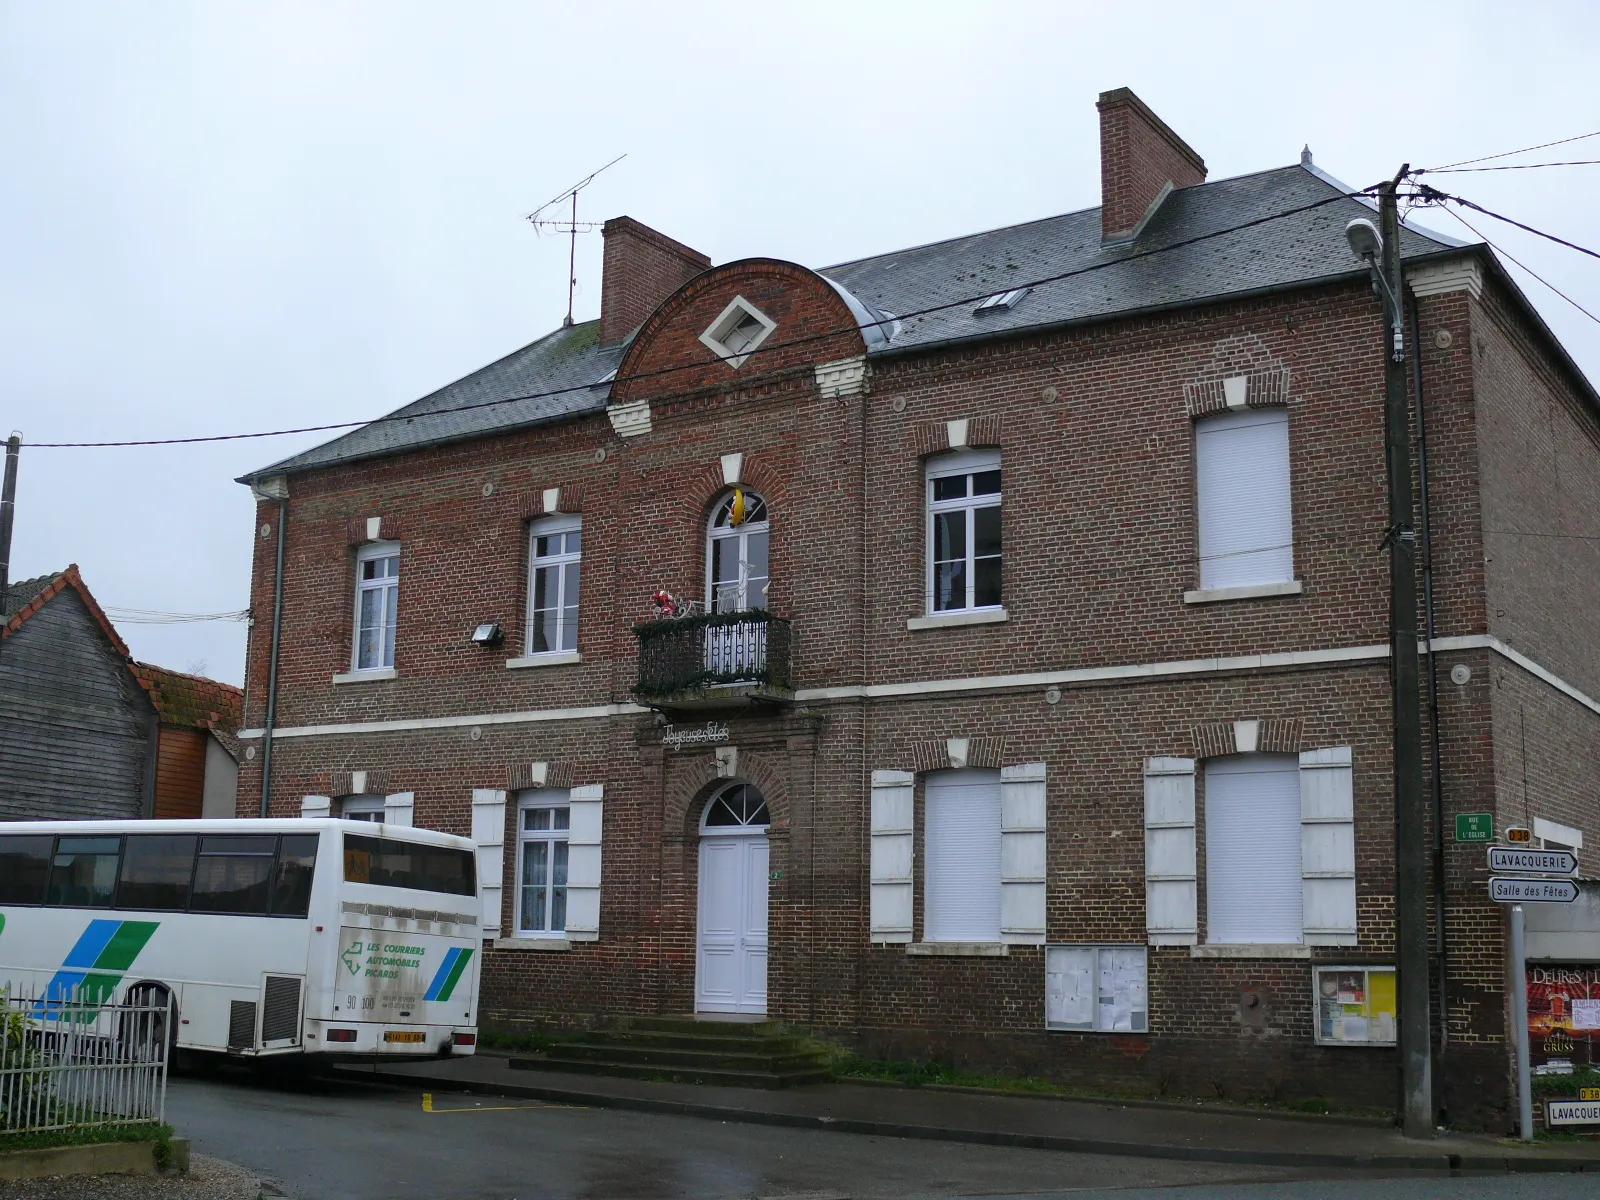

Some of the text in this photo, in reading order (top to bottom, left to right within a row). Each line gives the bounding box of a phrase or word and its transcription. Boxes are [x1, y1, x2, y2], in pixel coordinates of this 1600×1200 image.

[1509, 830, 1529, 841] D 38
[1495, 854, 1566, 868] LAVACQUERIE
[1497, 885, 1568, 897] Salle des Fêtes
[366, 943, 425, 956] LES COURRIERS
[366, 956, 420, 968] AUTOMOBILES
[365, 968, 399, 979] PICARDS
[347, 995, 357, 1009] 90
[362, 997, 375, 1010] 100
[1543, 1042, 1574, 1051] GRUSS
[1581, 1090, 1600, 1099] D 38
[1552, 1107, 1600, 1119] LAVACQUE
